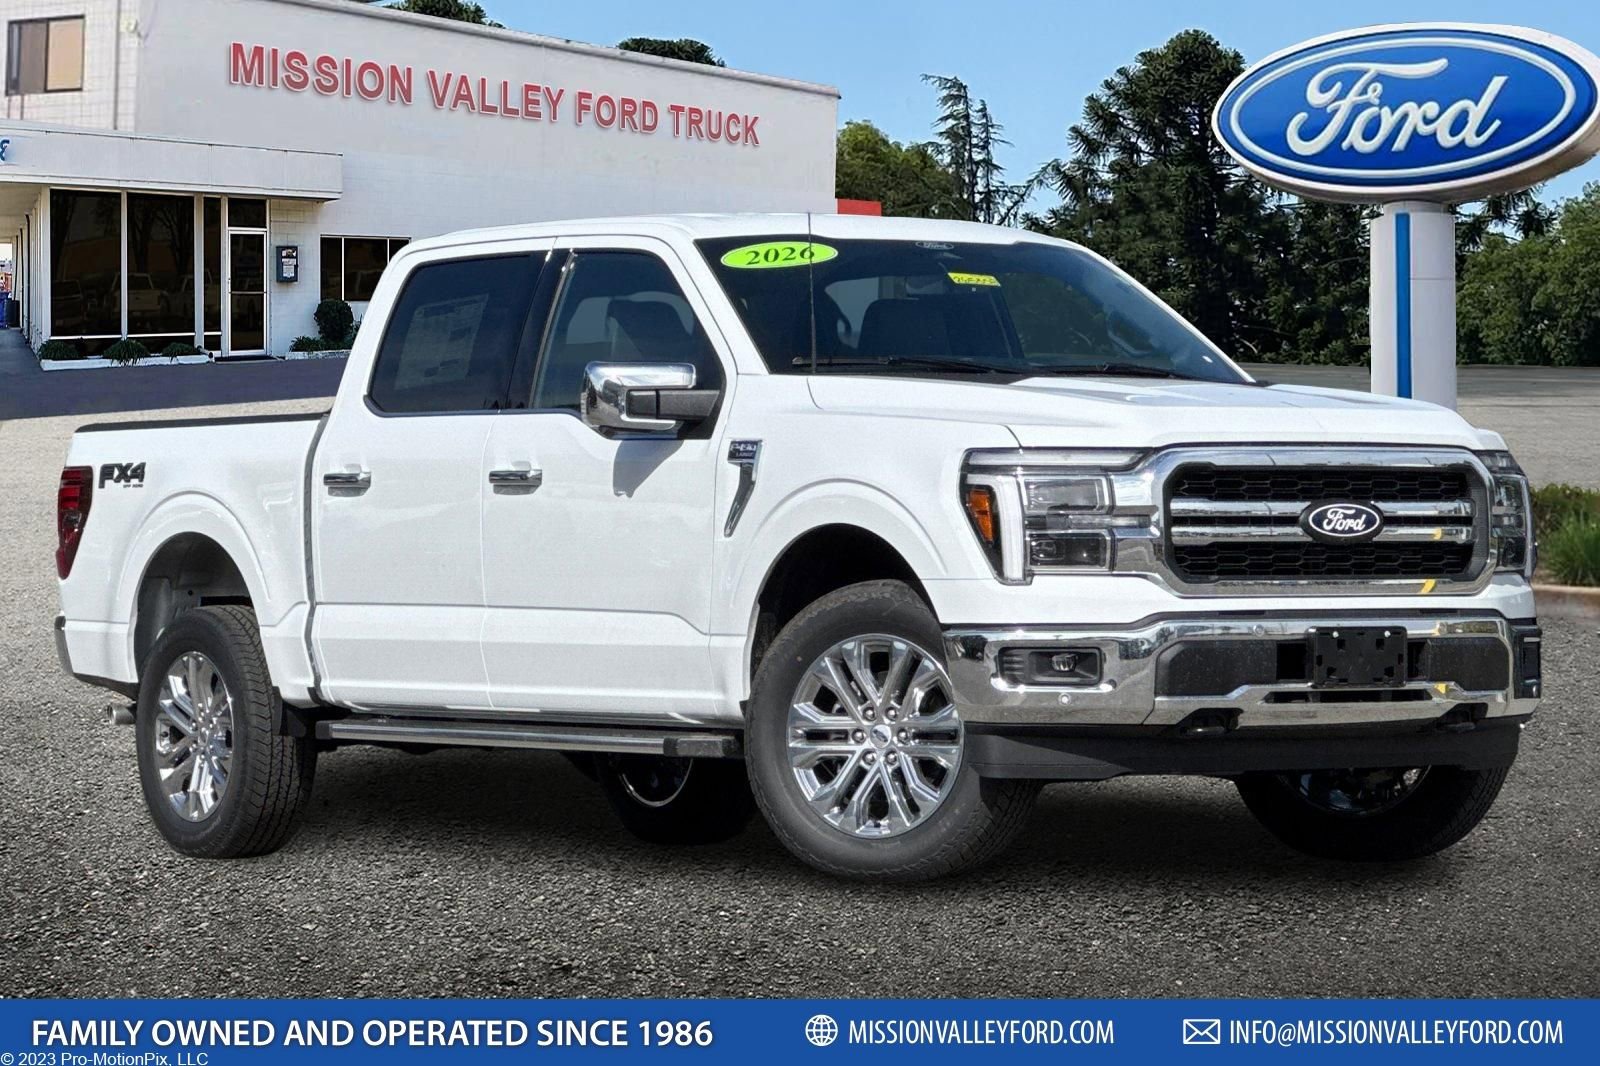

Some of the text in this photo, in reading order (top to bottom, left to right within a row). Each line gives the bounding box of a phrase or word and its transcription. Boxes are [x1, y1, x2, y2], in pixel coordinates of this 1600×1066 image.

[229, 41, 761, 146] MISSION VALLEY FORD TRUCK
[1286, 57, 1509, 157] Ford
[745, 246, 815, 266] 2026
[98, 462, 147, 489] FX4
[1322, 507, 1367, 531] Ford
